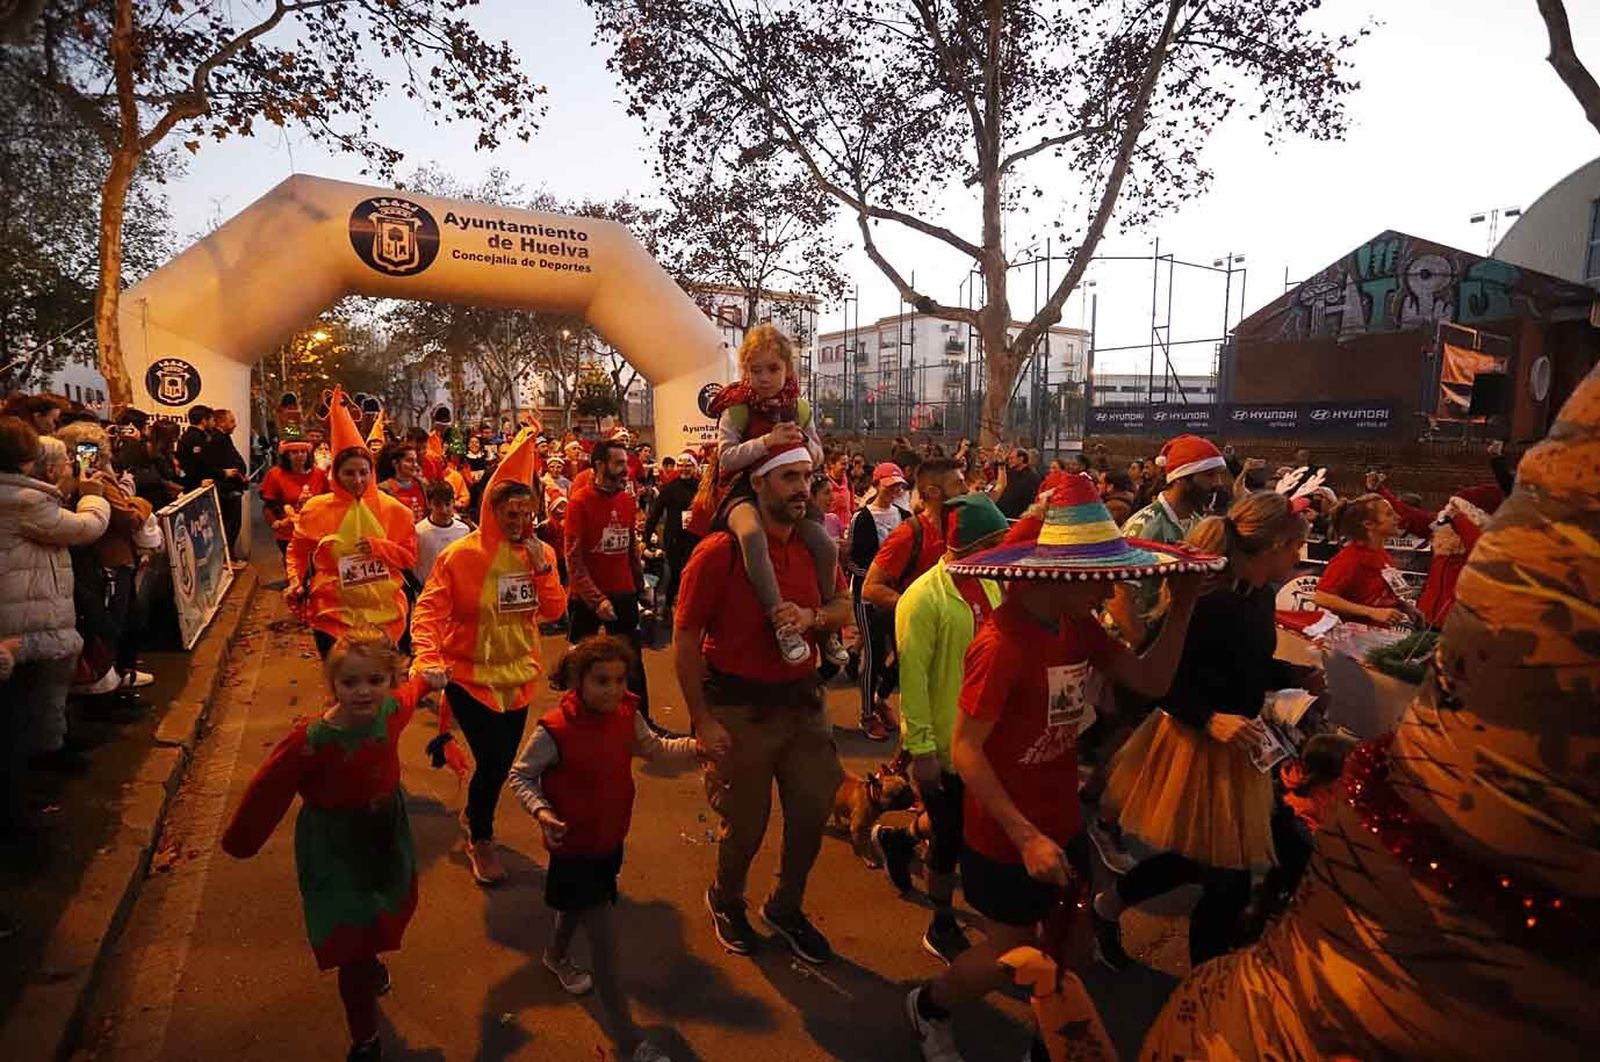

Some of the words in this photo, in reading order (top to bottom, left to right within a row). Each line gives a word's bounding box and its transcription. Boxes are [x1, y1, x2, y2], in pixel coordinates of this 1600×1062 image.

[444, 212, 588, 241] Ayuntamiento
[487, 234, 513, 250] de
[520, 237, 589, 259] Huelva
[521, 257, 536, 267] de
[539, 259, 592, 273] Deportes
[1250, 410, 1297, 419] HYUNDAI
[1332, 409, 1389, 419] HYUNDAI
[360, 561, 385, 577] 142
